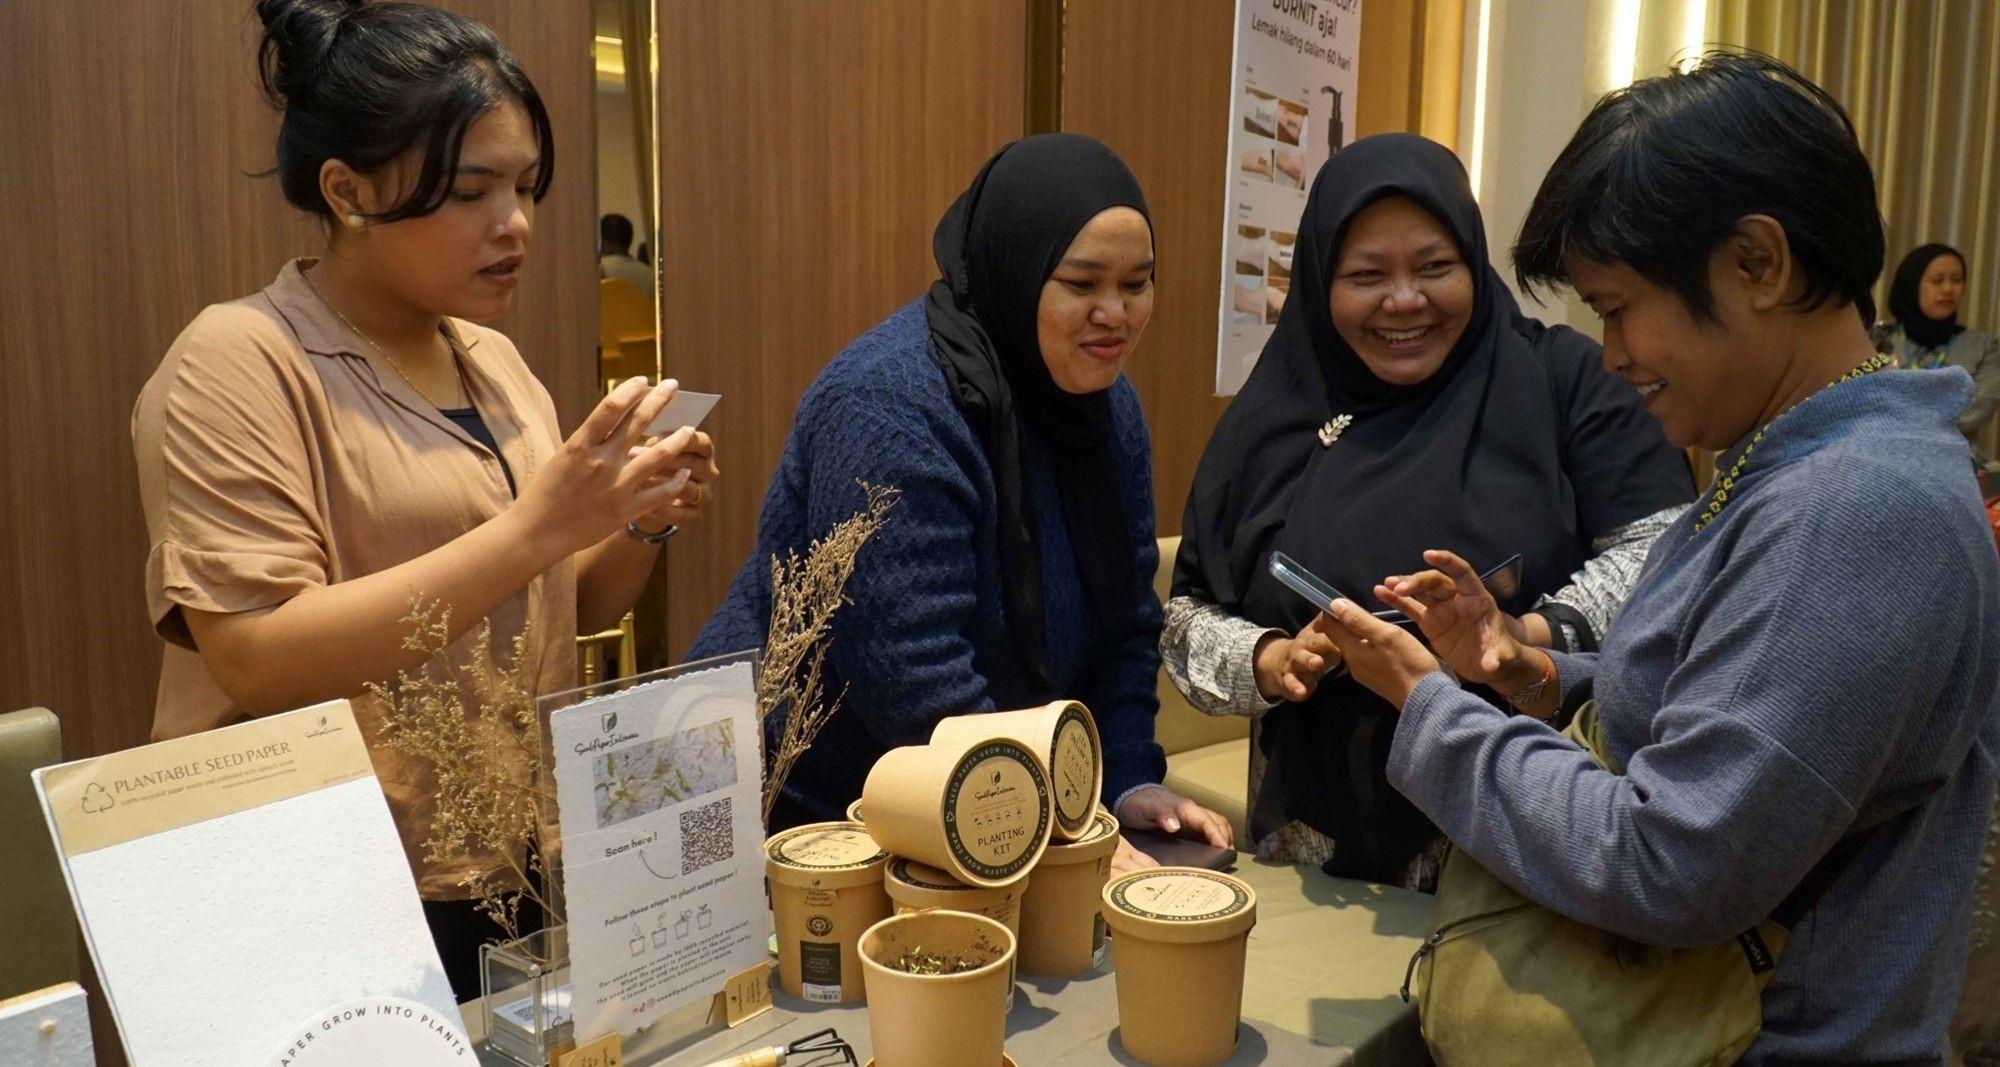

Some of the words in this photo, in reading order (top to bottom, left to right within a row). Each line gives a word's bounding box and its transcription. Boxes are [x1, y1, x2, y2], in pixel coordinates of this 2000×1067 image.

[1252, 12, 1278, 38] Lemak
[1318, 10, 1338, 38] aja!
[114, 762, 202, 794] PLANTABLE
[205, 753, 243, 772] SEED
[246, 742, 292, 762] PAPER
[958, 756, 977, 778] PAPER
[605, 844, 630, 857] Scan
[631, 836, 652, 848] here
[978, 826, 1024, 848] PLANTING
[993, 842, 1012, 856] KIT
[964, 856, 981, 871] FROM
[322, 1006, 366, 1030] GROW
[377, 1006, 412, 1018] INTO
[420, 1014, 466, 1056] PLANTS
